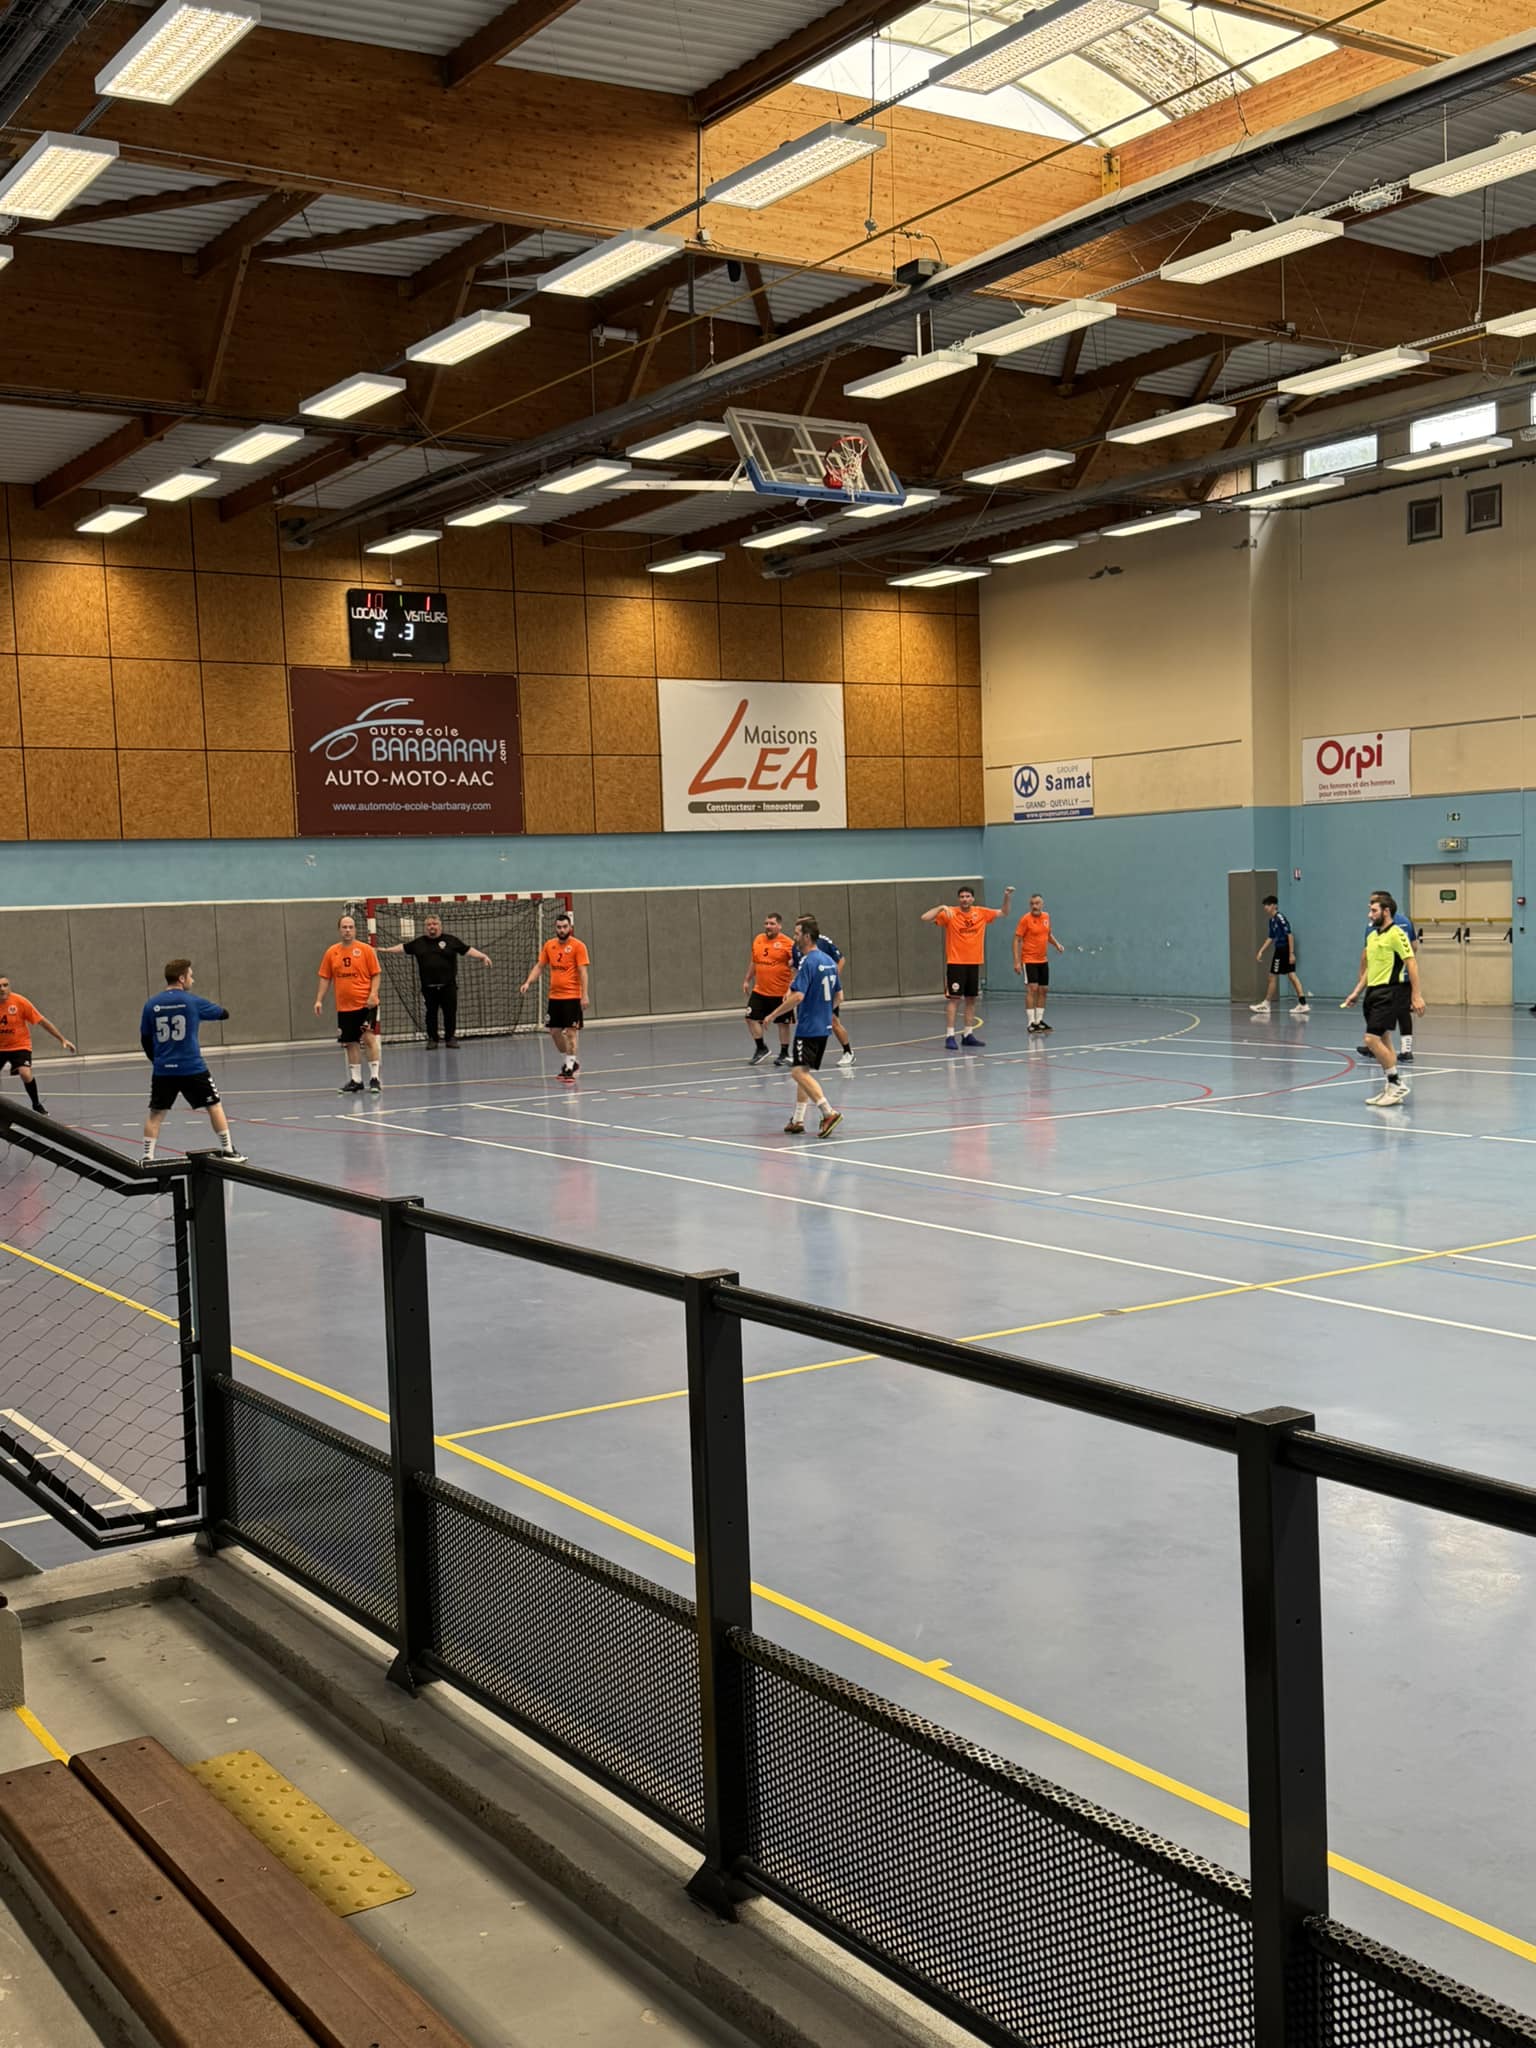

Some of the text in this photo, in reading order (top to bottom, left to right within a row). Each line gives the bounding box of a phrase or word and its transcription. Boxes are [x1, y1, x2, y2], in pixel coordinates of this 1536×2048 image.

[351, 607, 388, 620] LOCAUX
[404, 609, 448, 623] VISITEURS
[369, 725, 460, 737] auto-ecole
[744, 725, 818, 745] Maisons
[371, 737, 498, 763] BARBARAY
[499, 739, 507, 764] .com
[688, 698, 819, 796] LEA
[1316, 733, 1384, 779] Orpi
[324, 769, 494, 787] AUTO-MOTO-AAC
[1045, 771, 1091, 791] Samat
[333, 801, 492, 813] www.automoto-ecole-barbaray.com
[706, 802, 756, 812] Constructeur
[762, 801, 804, 811] Innovateur
[155, 1014, 187, 1043] 53
